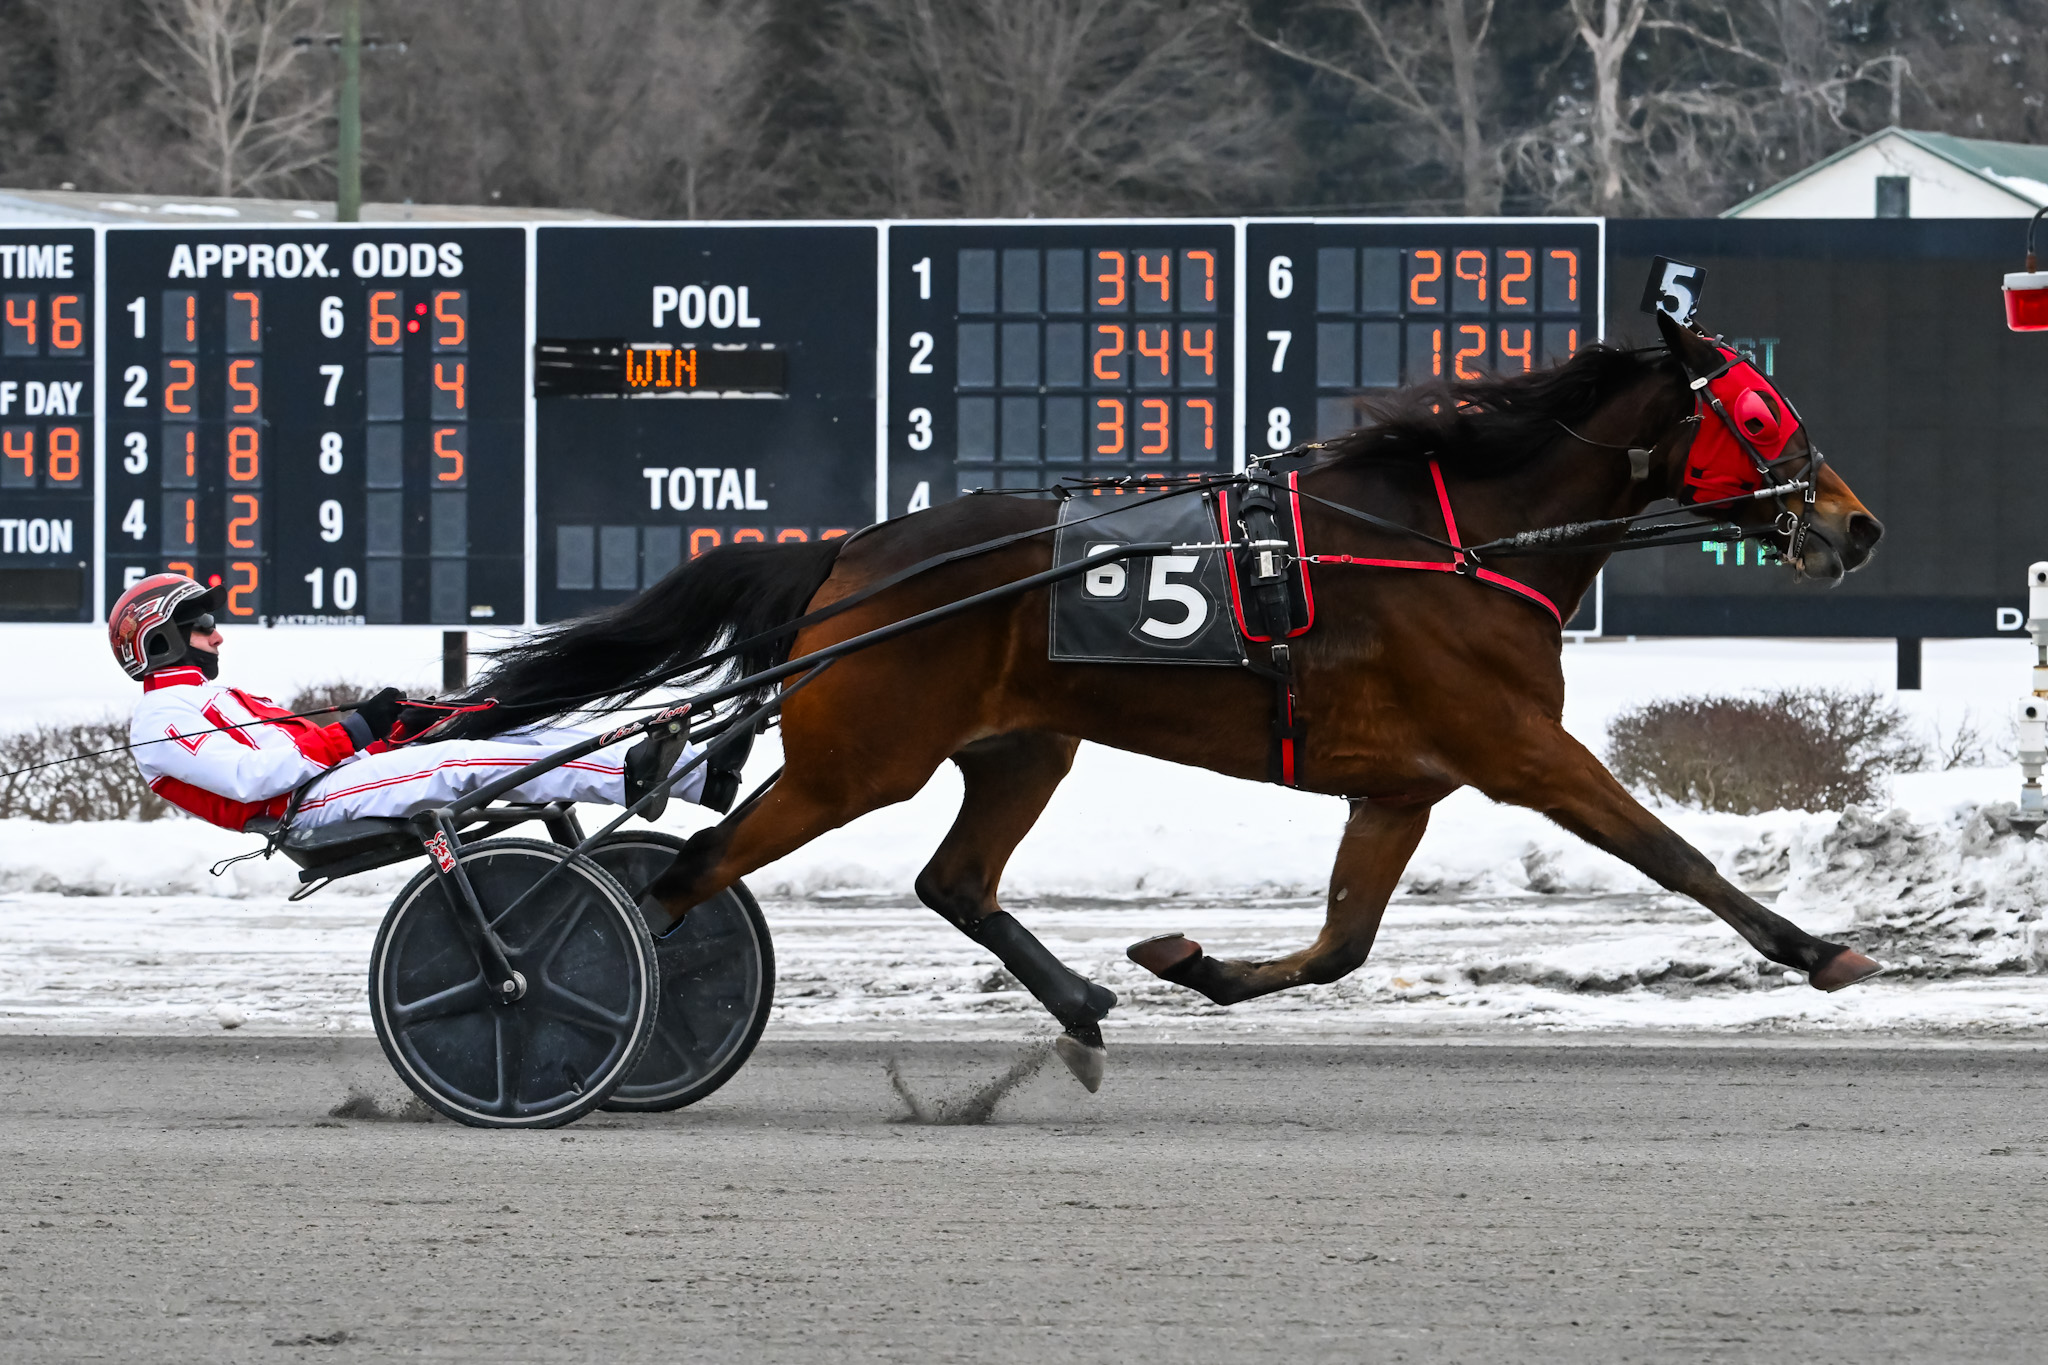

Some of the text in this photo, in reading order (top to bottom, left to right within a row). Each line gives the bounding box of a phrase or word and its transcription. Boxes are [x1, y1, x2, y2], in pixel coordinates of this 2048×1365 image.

[0, 245, 73, 278] TIME
[168, 243, 463, 278] APPROX. ODDS
[912, 258, 930, 299] 1
[1098, 251, 1213, 305] 347
[1269, 256, 1293, 298] 6
[1411, 251, 1576, 304] 2927
[653, 285, 760, 328] POOL
[1656, 262, 1698, 328] 5
[7, 296, 81, 348] 46
[127, 297, 145, 338] 1
[321, 296, 343, 338] 6
[627, 350, 696, 387] WIN
[909, 332, 933, 373] 2
[1094, 326, 1213, 379] 244
[1267, 331, 1291, 372] 7
[26, 382, 82, 415] DAY
[124, 366, 147, 407] 2
[320, 365, 343, 406] 7
[435, 364, 464, 408] 4
[908, 408, 932, 450] 3
[1098, 400, 1213, 453] 337
[1267, 407, 1292, 450] 8
[4, 428, 79, 480] 48
[124, 432, 147, 474] 3
[320, 432, 342, 474] 8
[435, 429, 463, 480] 5
[643, 467, 768, 510] TOTAL
[122, 499, 146, 540] 4
[320, 500, 343, 542] 9
[305, 568, 357, 610] 10
[1140, 555, 1208, 640] 5
